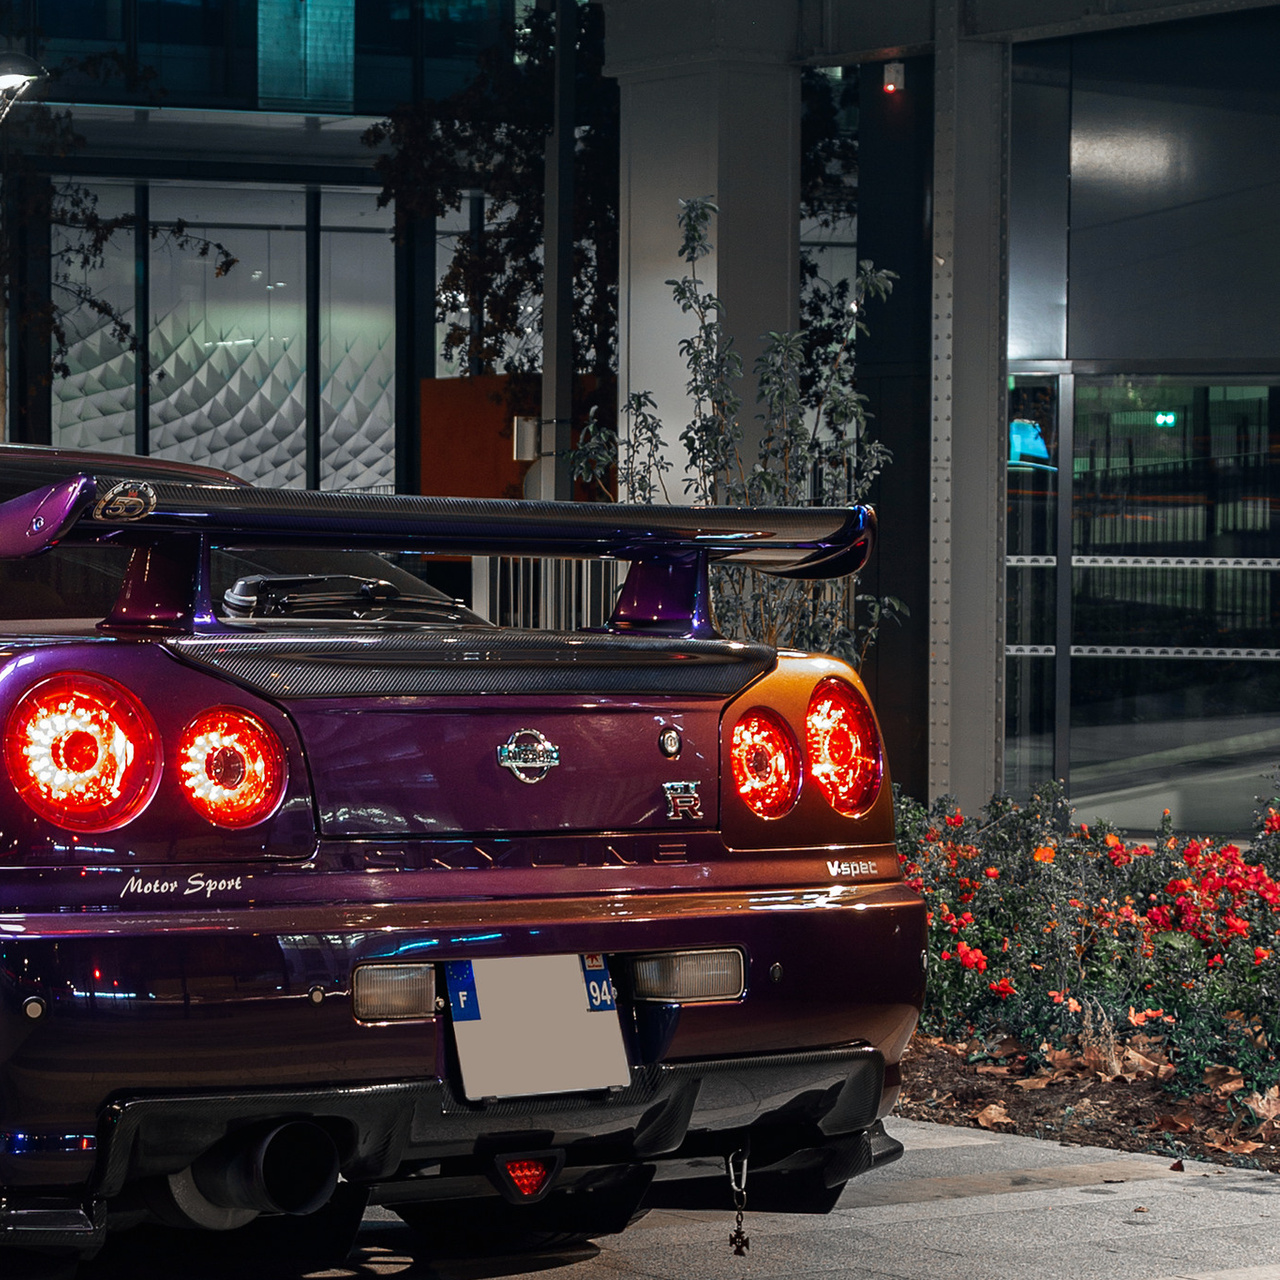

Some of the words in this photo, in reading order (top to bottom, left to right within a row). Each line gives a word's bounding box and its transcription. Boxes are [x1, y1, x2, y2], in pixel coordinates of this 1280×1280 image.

[365, 844, 688, 871] SKYLINE
[120, 876, 178, 898] Motor
[183, 872, 243, 898] Sport
[458, 991, 468, 1008] F
[589, 980, 613, 1006] 94
